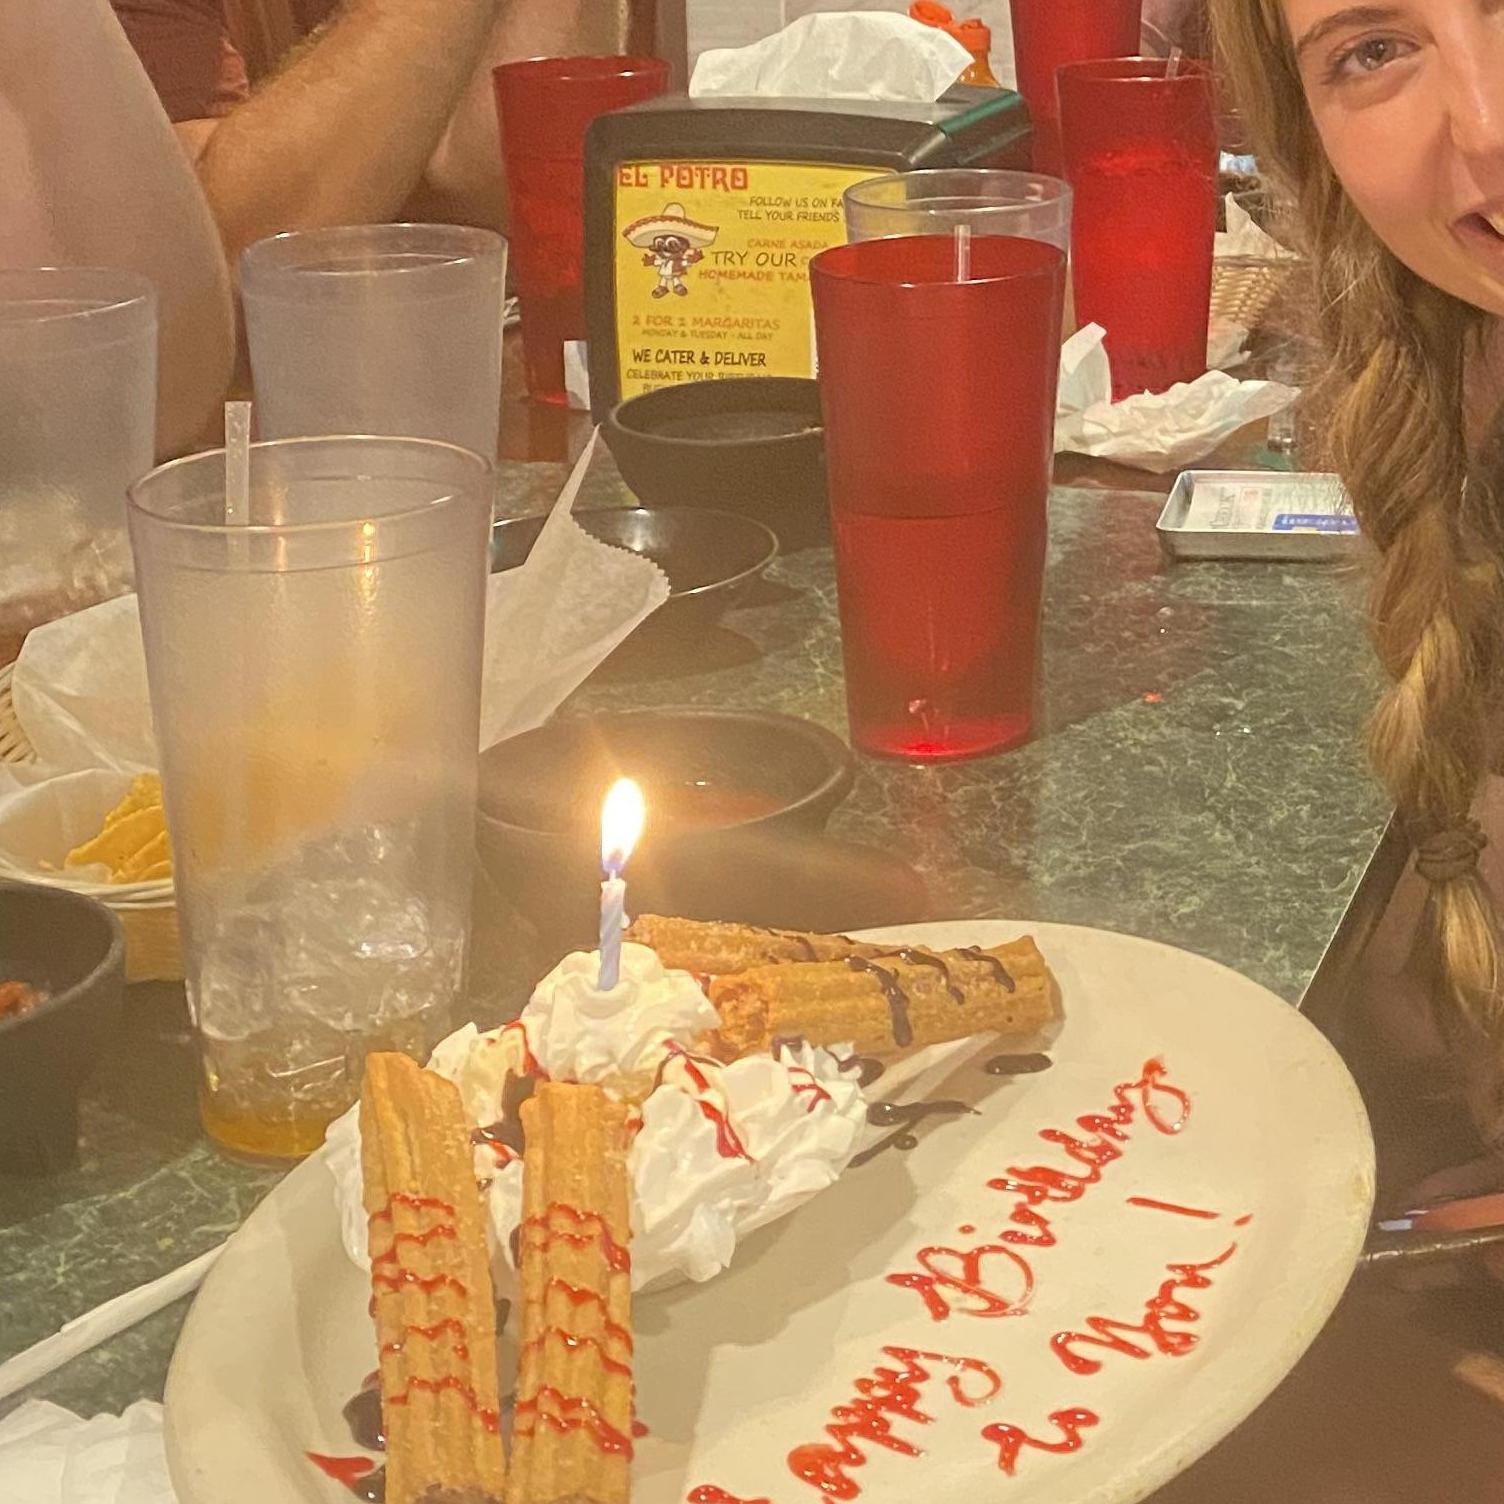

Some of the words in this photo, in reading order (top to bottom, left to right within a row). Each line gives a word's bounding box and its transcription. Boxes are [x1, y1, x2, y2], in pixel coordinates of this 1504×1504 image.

[618, 165, 648, 187] EL
[660, 165, 749, 192] POTRO
[749, 196, 792, 207] FOLLOW
[795, 197, 809, 208] US
[811, 198, 827, 208] ON
[831, 199, 843, 208] FA
[737, 209, 761, 220] TELL
[765, 210, 794, 221] YOUR
[796, 211, 840, 223] FRIENDS
[747, 238, 786, 248] CARNE
[790, 239, 828, 249] ASADA
[712, 251, 748, 266] TRY
[755, 251, 797, 267] OUR
[698, 269, 774, 281] HOMEMADE
[779, 271, 809, 282] TAM
[645, 315, 673, 326] FOR
[692, 317, 781, 330] MARGARITAS
[690, 330, 728, 339] TUESDAY
[632, 349, 651, 363] WE
[655, 350, 696, 365] CATER
[699, 351, 710, 365] &
[714, 352, 767, 367] DELIVER
[626, 368, 684, 381] CELEBRATE
